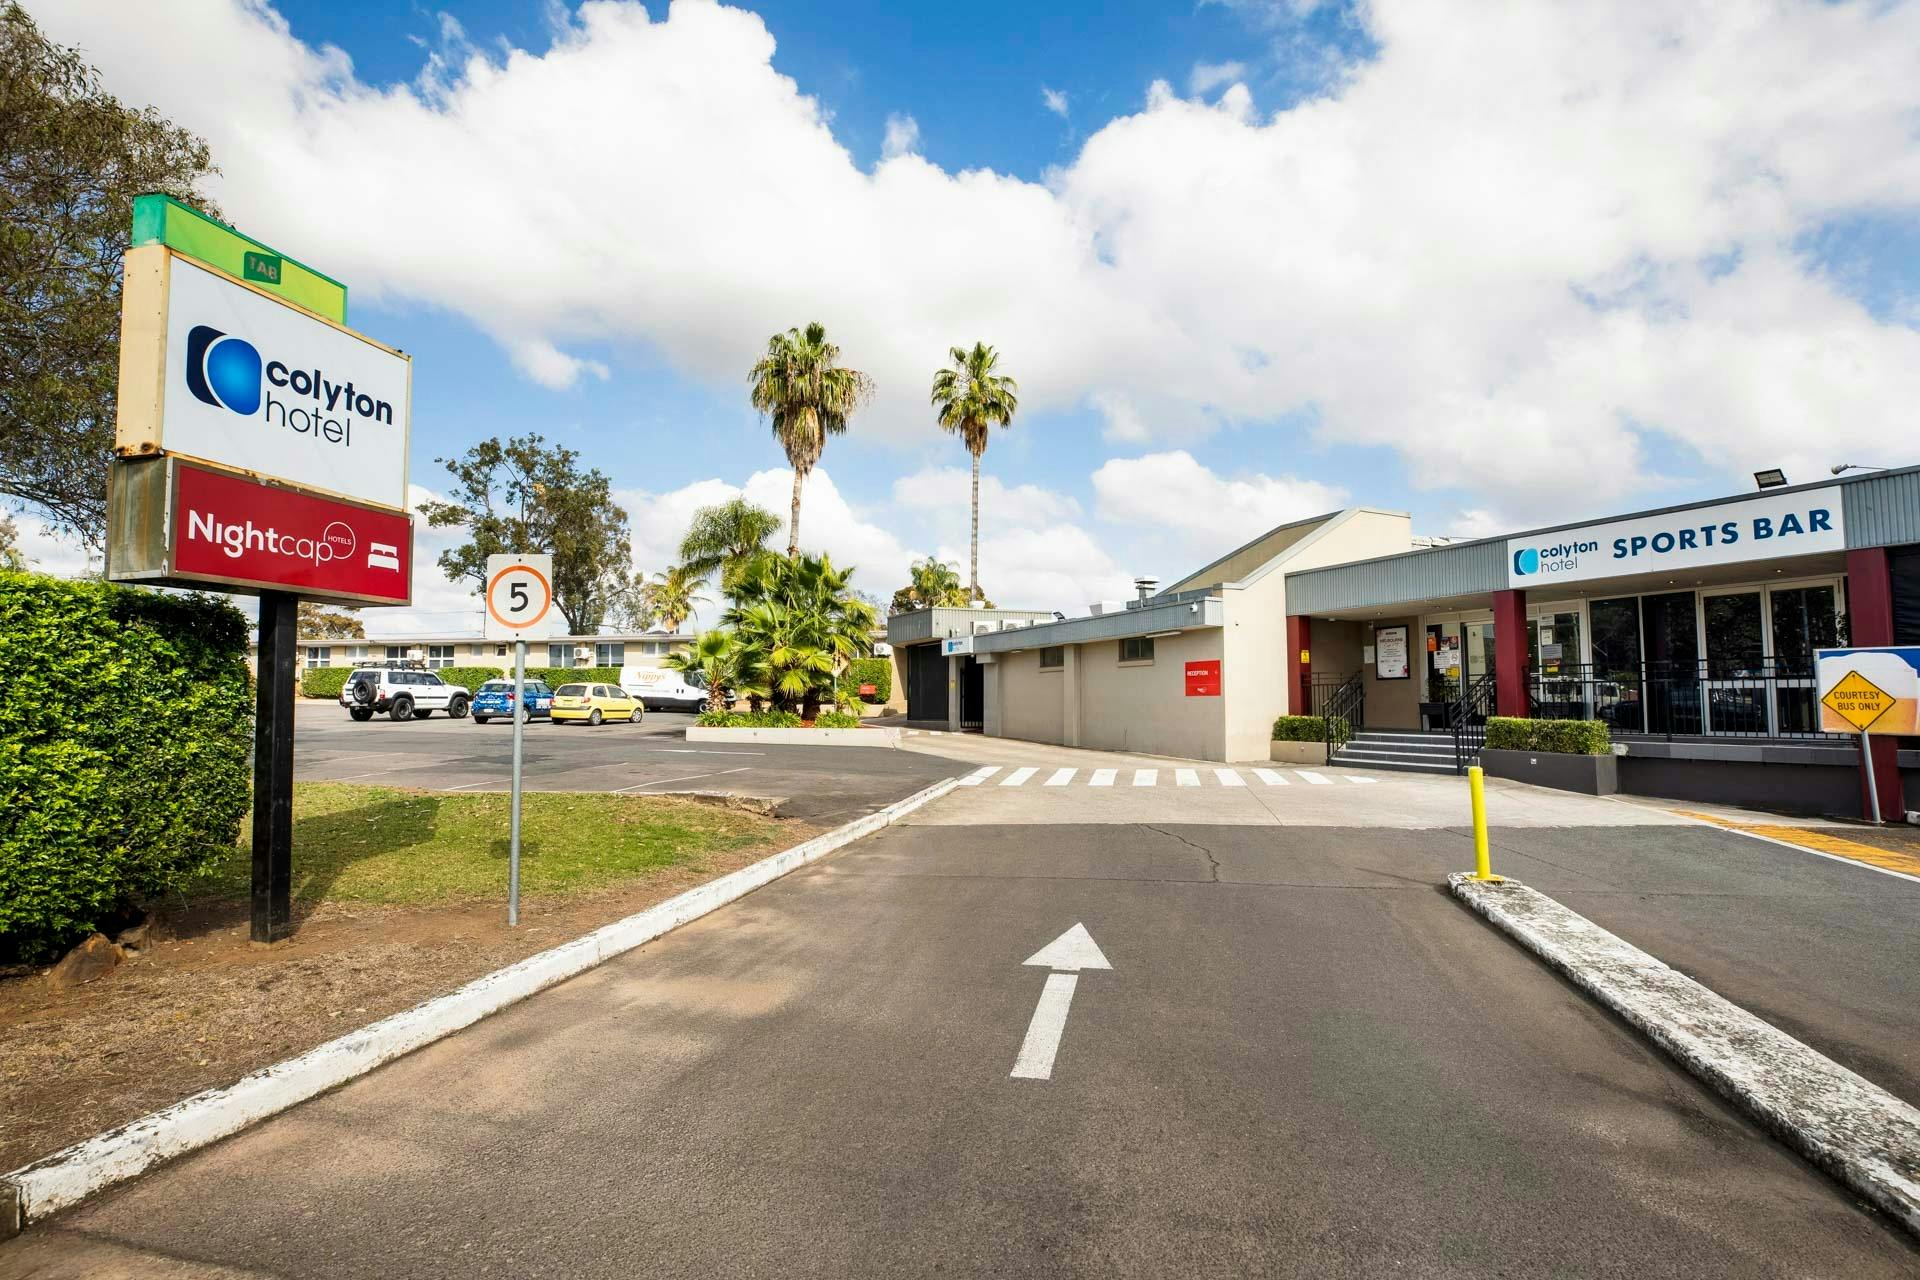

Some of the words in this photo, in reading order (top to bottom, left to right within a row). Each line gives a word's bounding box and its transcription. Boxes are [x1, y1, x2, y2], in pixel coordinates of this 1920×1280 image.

[248, 256, 279, 281] TAB
[266, 361, 393, 425] colyton
[266, 391, 350, 447] hotel
[188, 510, 333, 567] Nightcap
[327, 534, 352, 547] HOTELS
[1613, 521, 1739, 559] SPORTS
[1754, 509, 1833, 540] BAR
[1540, 539, 1598, 559] colyton
[1540, 556, 1578, 573] hotel
[510, 582, 529, 612] 5
[1834, 691, 1880, 700] COURTESY
[1837, 702, 1856, 711] BUS
[1858, 702, 1881, 711] ONLY
